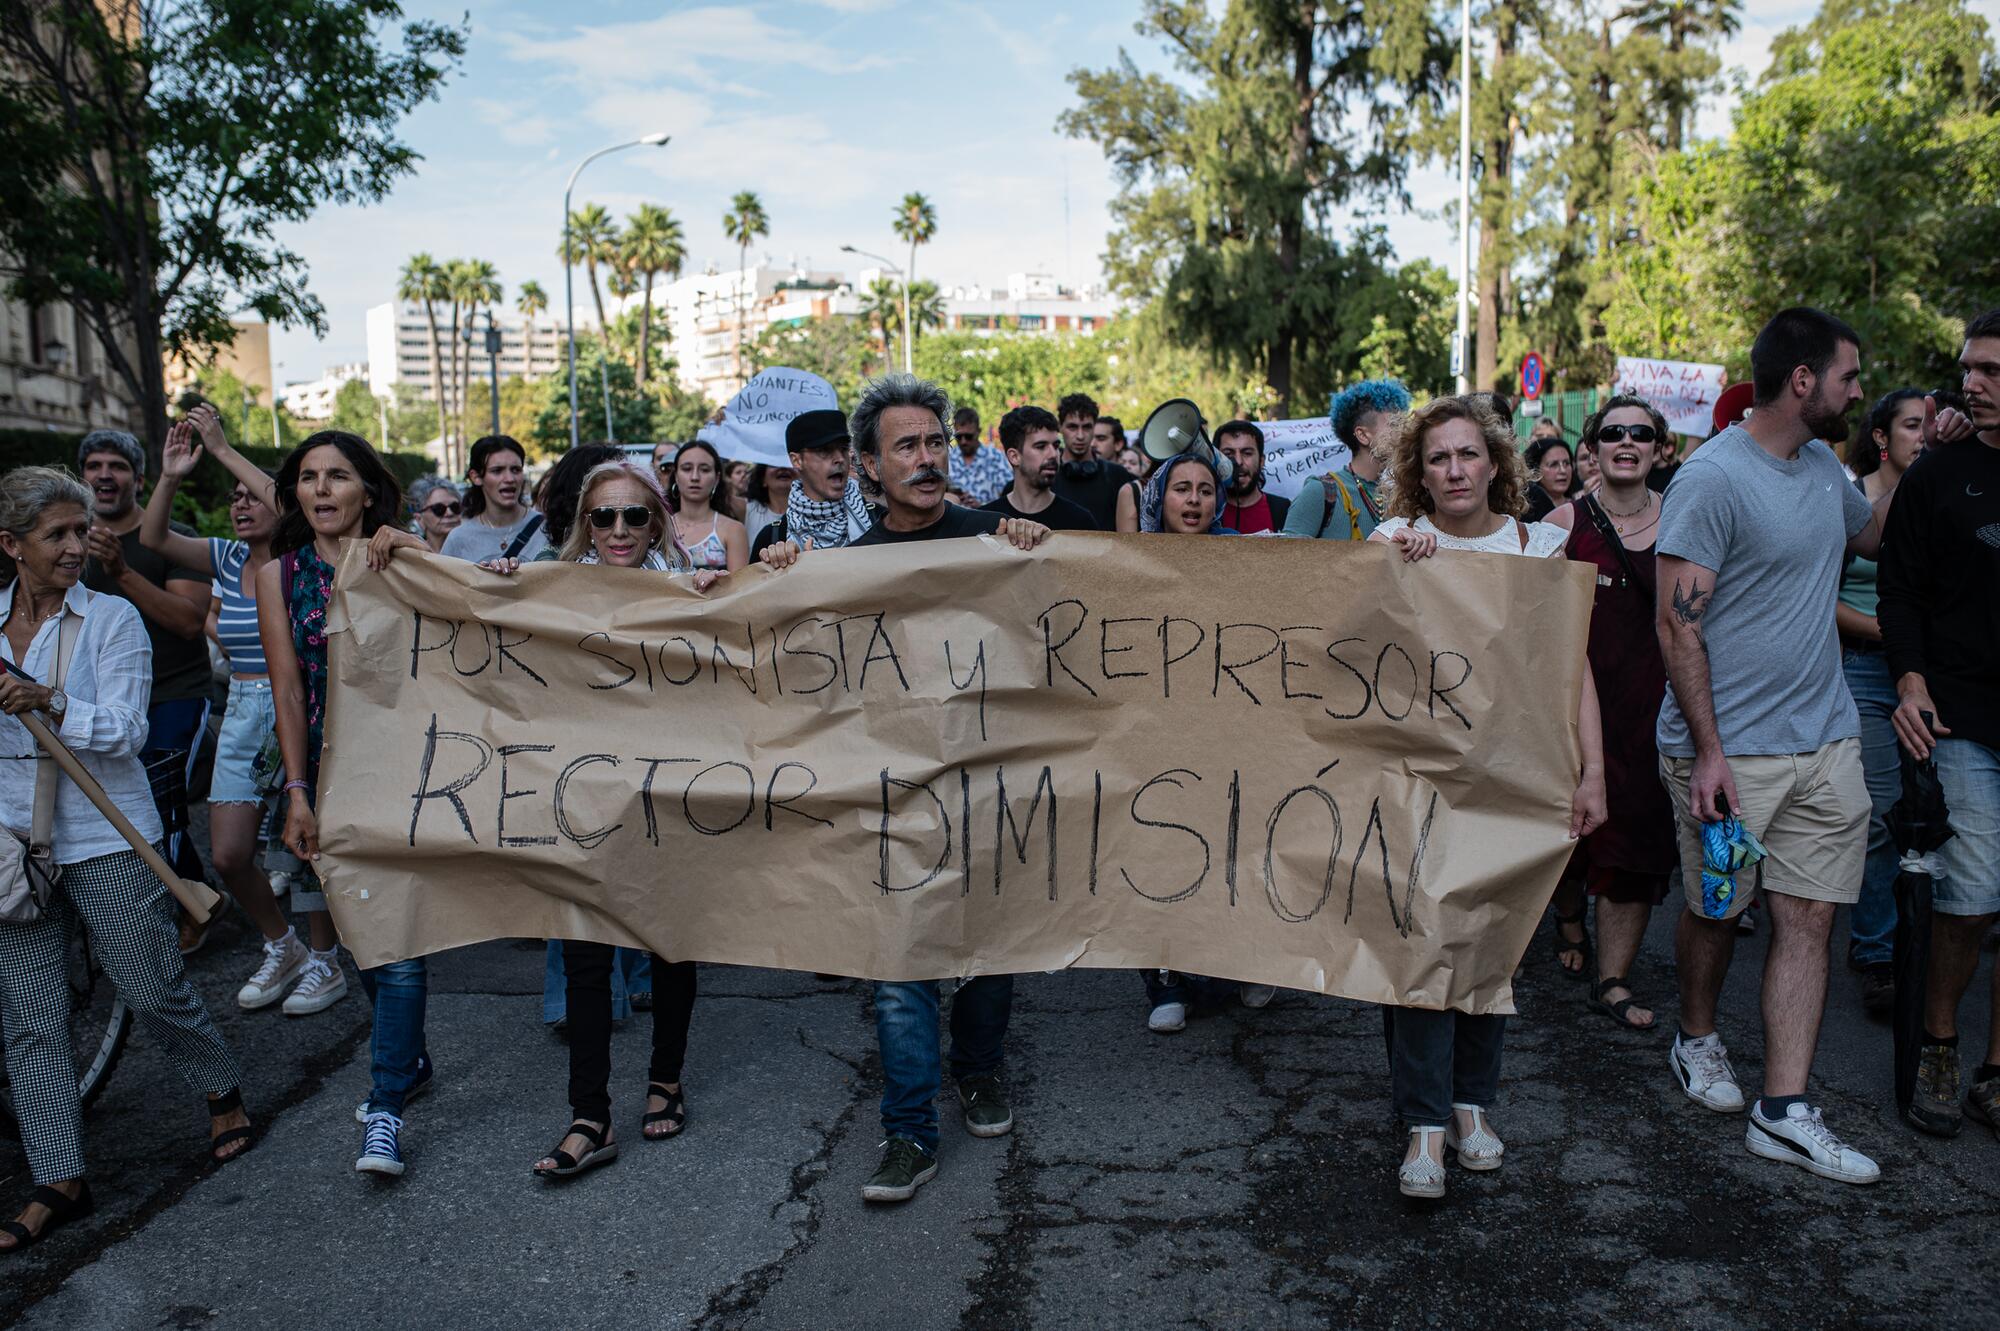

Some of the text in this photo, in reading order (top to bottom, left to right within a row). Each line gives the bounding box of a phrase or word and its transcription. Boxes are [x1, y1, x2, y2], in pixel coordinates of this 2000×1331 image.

[1623, 362, 1705, 381] VIVA LA
[738, 392, 769, 412] NO
[1264, 448, 1286, 462] OR
[410, 607, 548, 687] POR
[578, 611, 910, 696] SIONISTA
[1036, 599, 1472, 730] REPRESOR
[410, 713, 1438, 938] RECTOR DIMISIÓN
